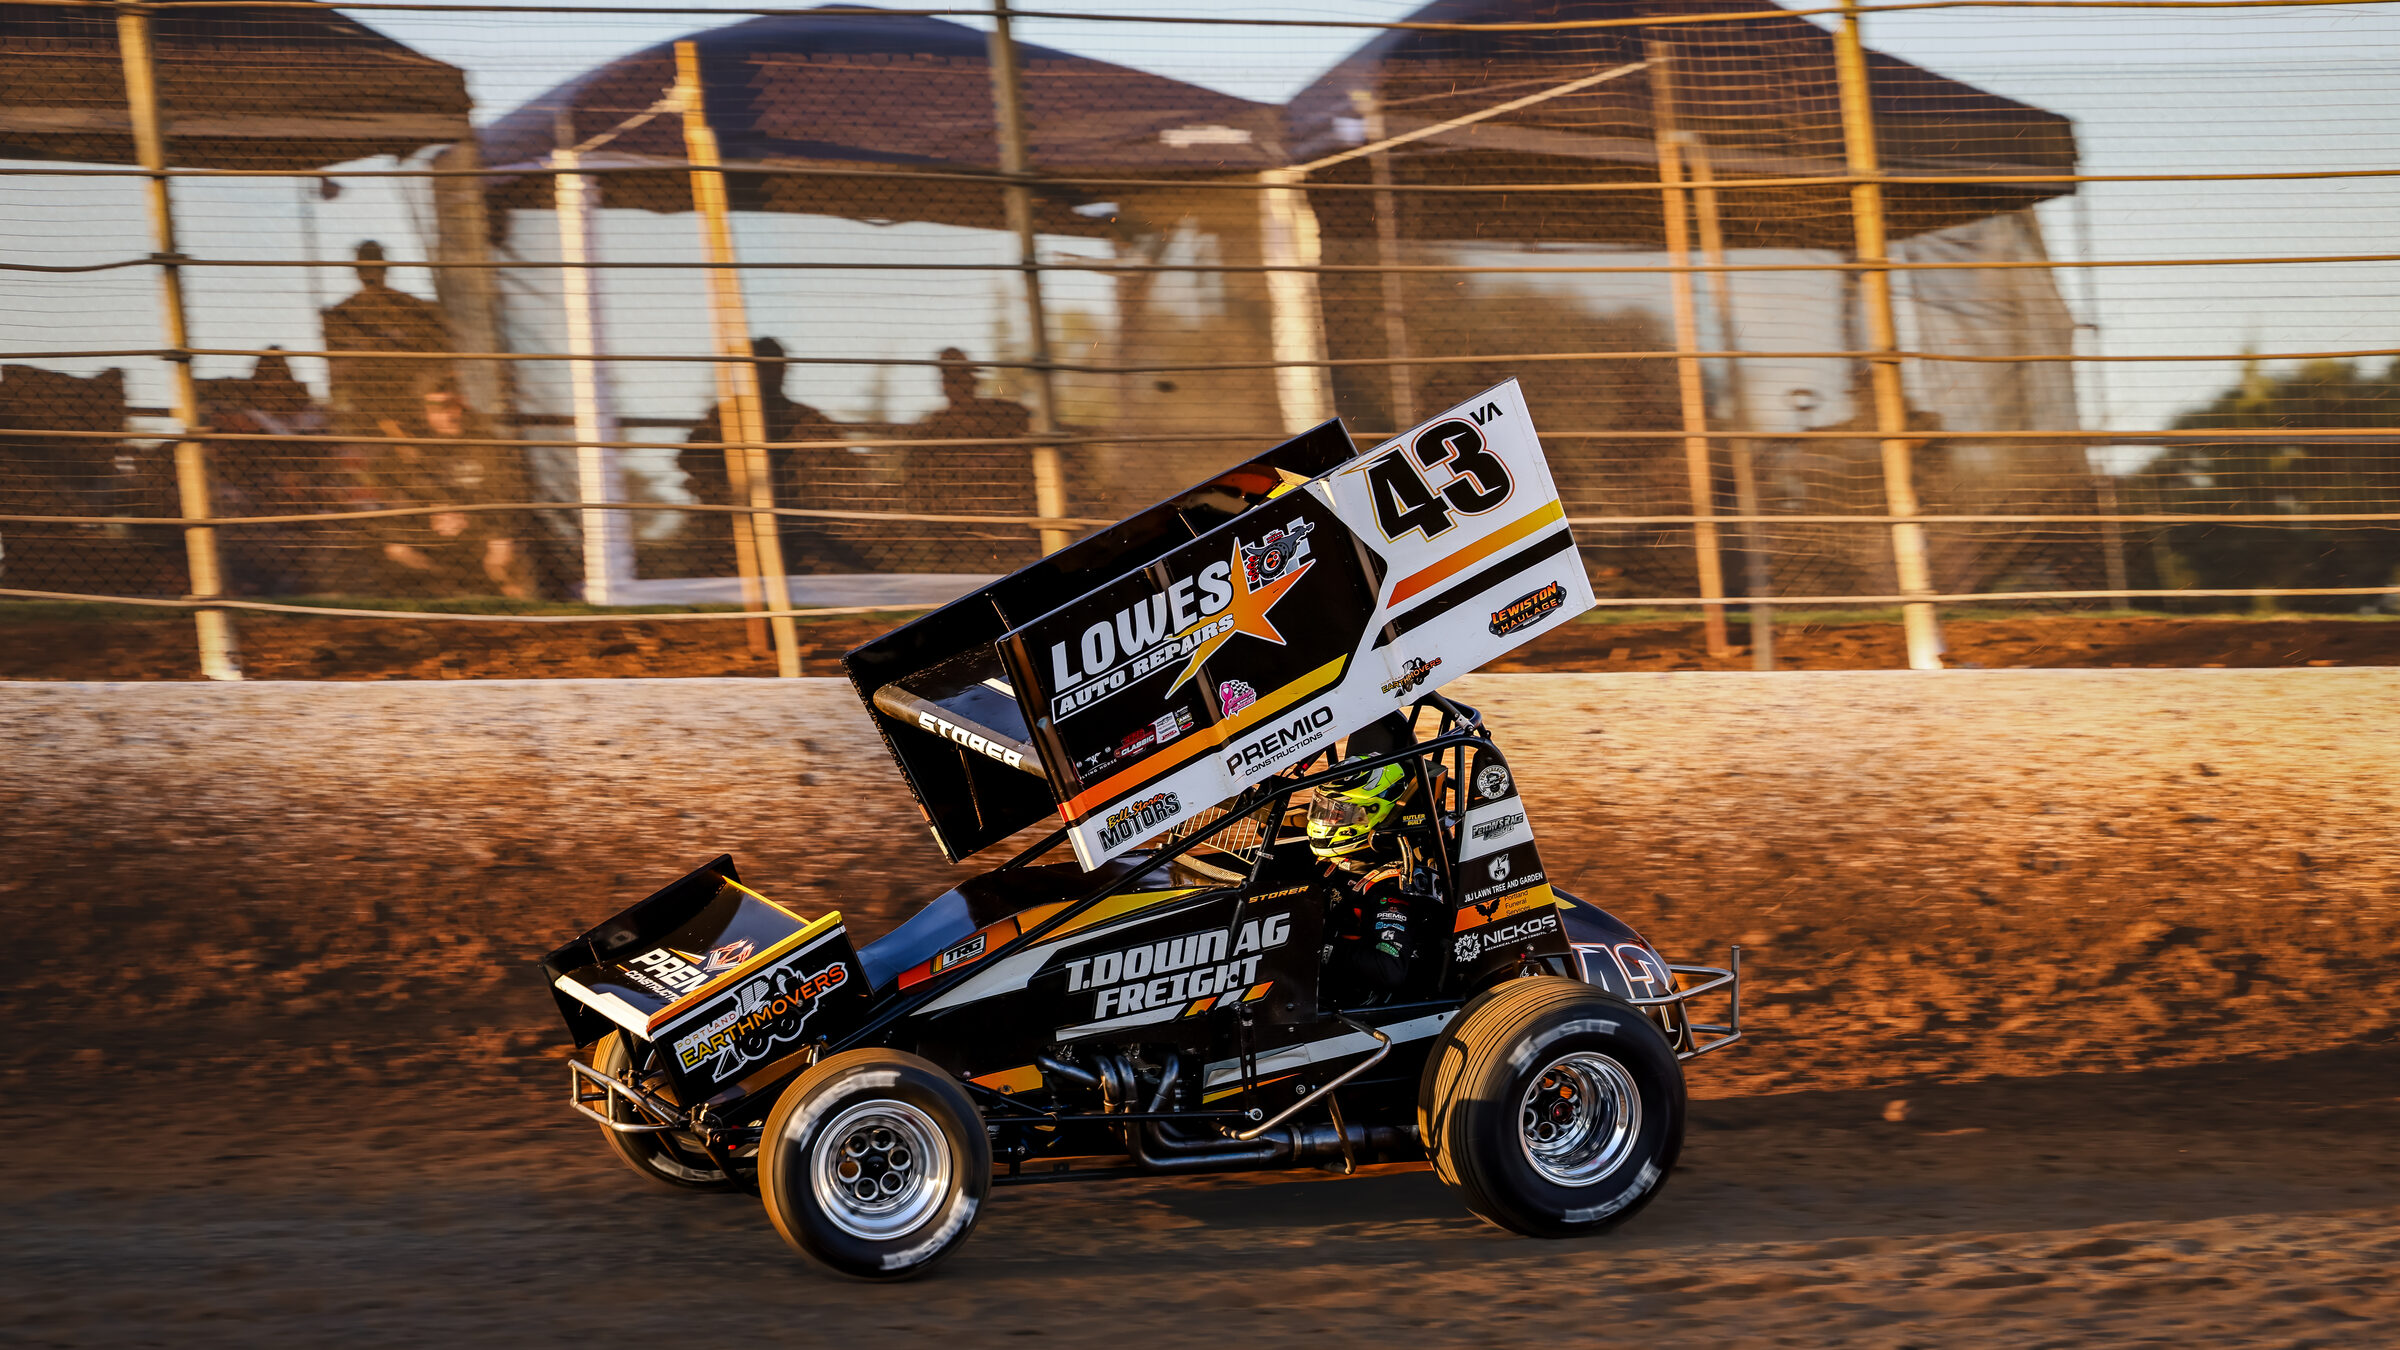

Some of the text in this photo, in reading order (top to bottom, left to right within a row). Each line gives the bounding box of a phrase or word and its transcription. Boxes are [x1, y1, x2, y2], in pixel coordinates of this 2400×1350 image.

[1469, 402, 1503, 426] VA
[1362, 417, 1514, 543] 43
[1491, 582, 1557, 625] LEWISTON
[1501, 598, 1558, 633] HAULAGE
[1051, 560, 1233, 693] LOWES
[1059, 613, 1235, 716] AUTO REPAIRS
[1381, 656, 1442, 694] EARTHMOVERS
[1121, 734, 1155, 756] CLASSIC
[1226, 705, 1334, 776] PREMIO
[1245, 731, 1324, 777] CONSTRUCTIONS
[1097, 791, 1181, 852] MOTORS
[1107, 806, 1130, 830] Bill
[1402, 813, 1426, 821] BUTLER
[1249, 886, 1309, 904] STORER
[1474, 887, 1492, 900] LAWN
[1492, 882, 1507, 893] TREE
[1507, 878, 1519, 888] AND
[1520, 871, 1543, 884] GARDEN
[1504, 890, 1529, 902] Portland
[1505, 898, 1528, 909] Funeral
[1377, 912, 1407, 921] PREMIO
[1483, 914, 1557, 947] NICKOS
[1066, 912, 1291, 993] T.DOWN AG
[1095, 954, 1263, 1020] FREIGHT
[676, 1012, 737, 1049] PORTLAND
[682, 966, 845, 1067] EARTHMOVERS
